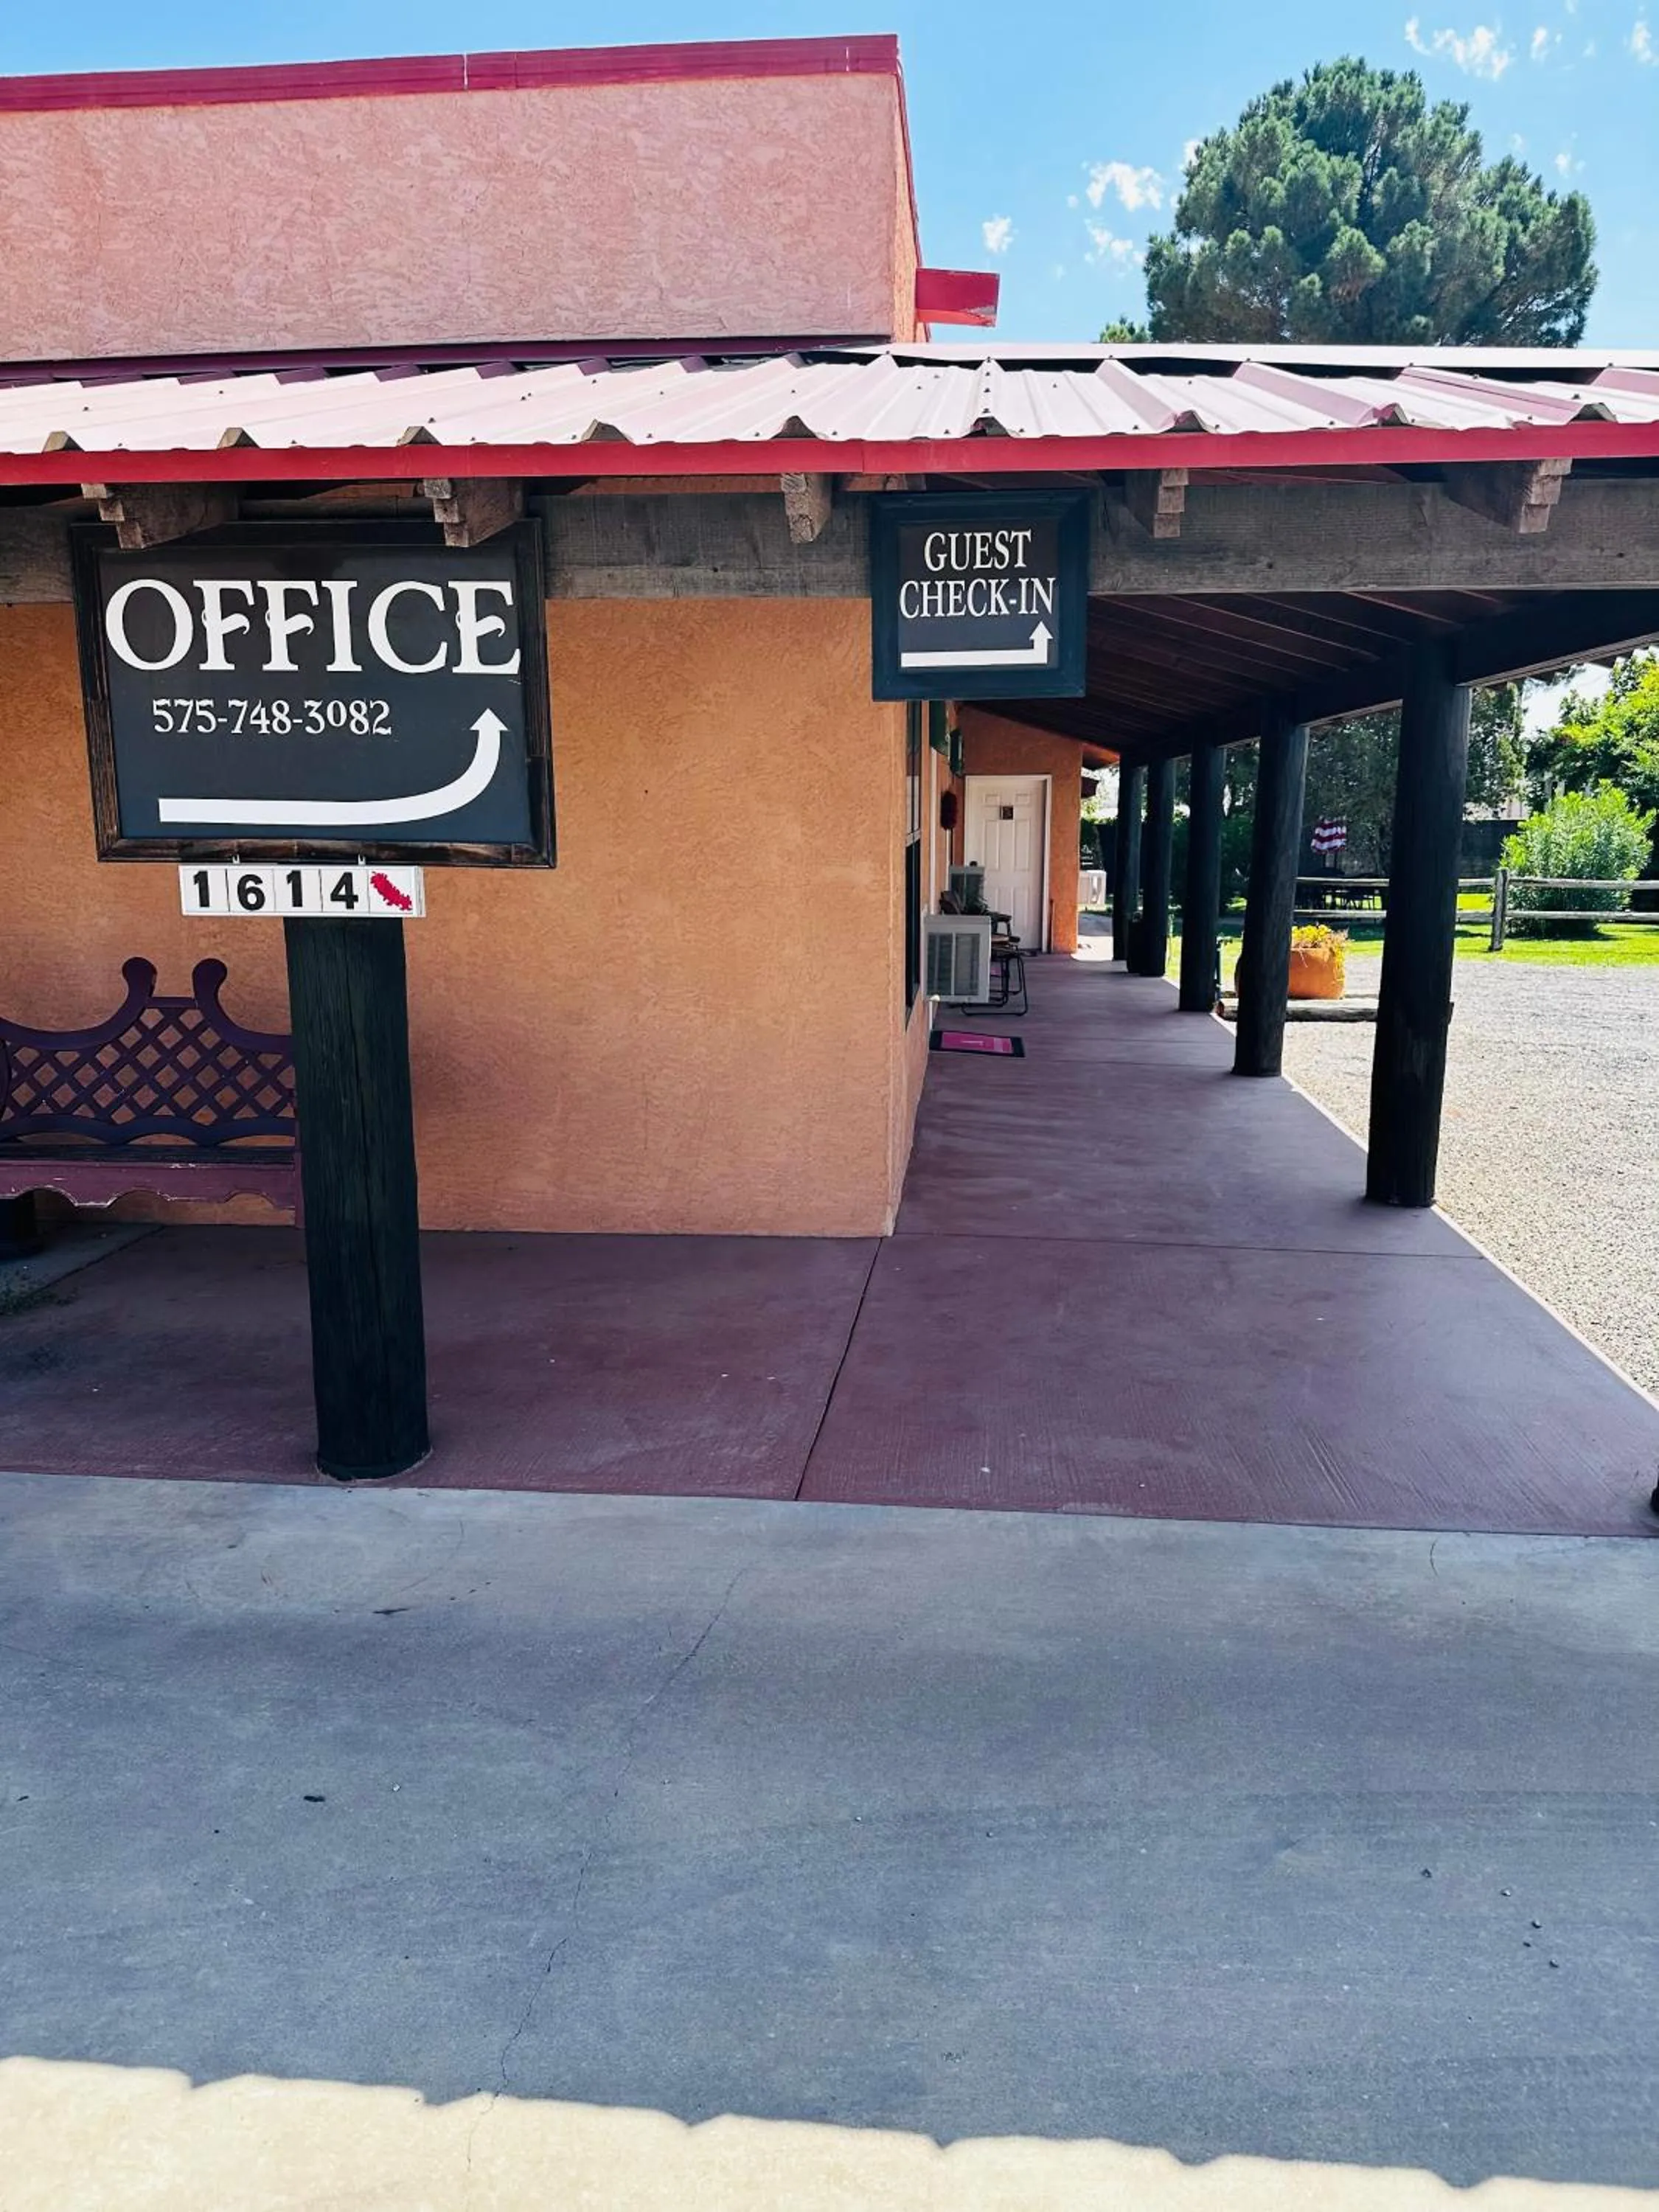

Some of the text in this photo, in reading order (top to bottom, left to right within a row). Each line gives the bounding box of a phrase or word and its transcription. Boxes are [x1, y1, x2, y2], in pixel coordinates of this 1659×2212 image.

[924, 529, 1032, 571] GUEST
[900, 577, 1056, 619] CHECK-IN
[105, 579, 521, 675] OFFICE
[152, 698, 392, 735] 575-748-3082
[193, 870, 359, 911] 1614
